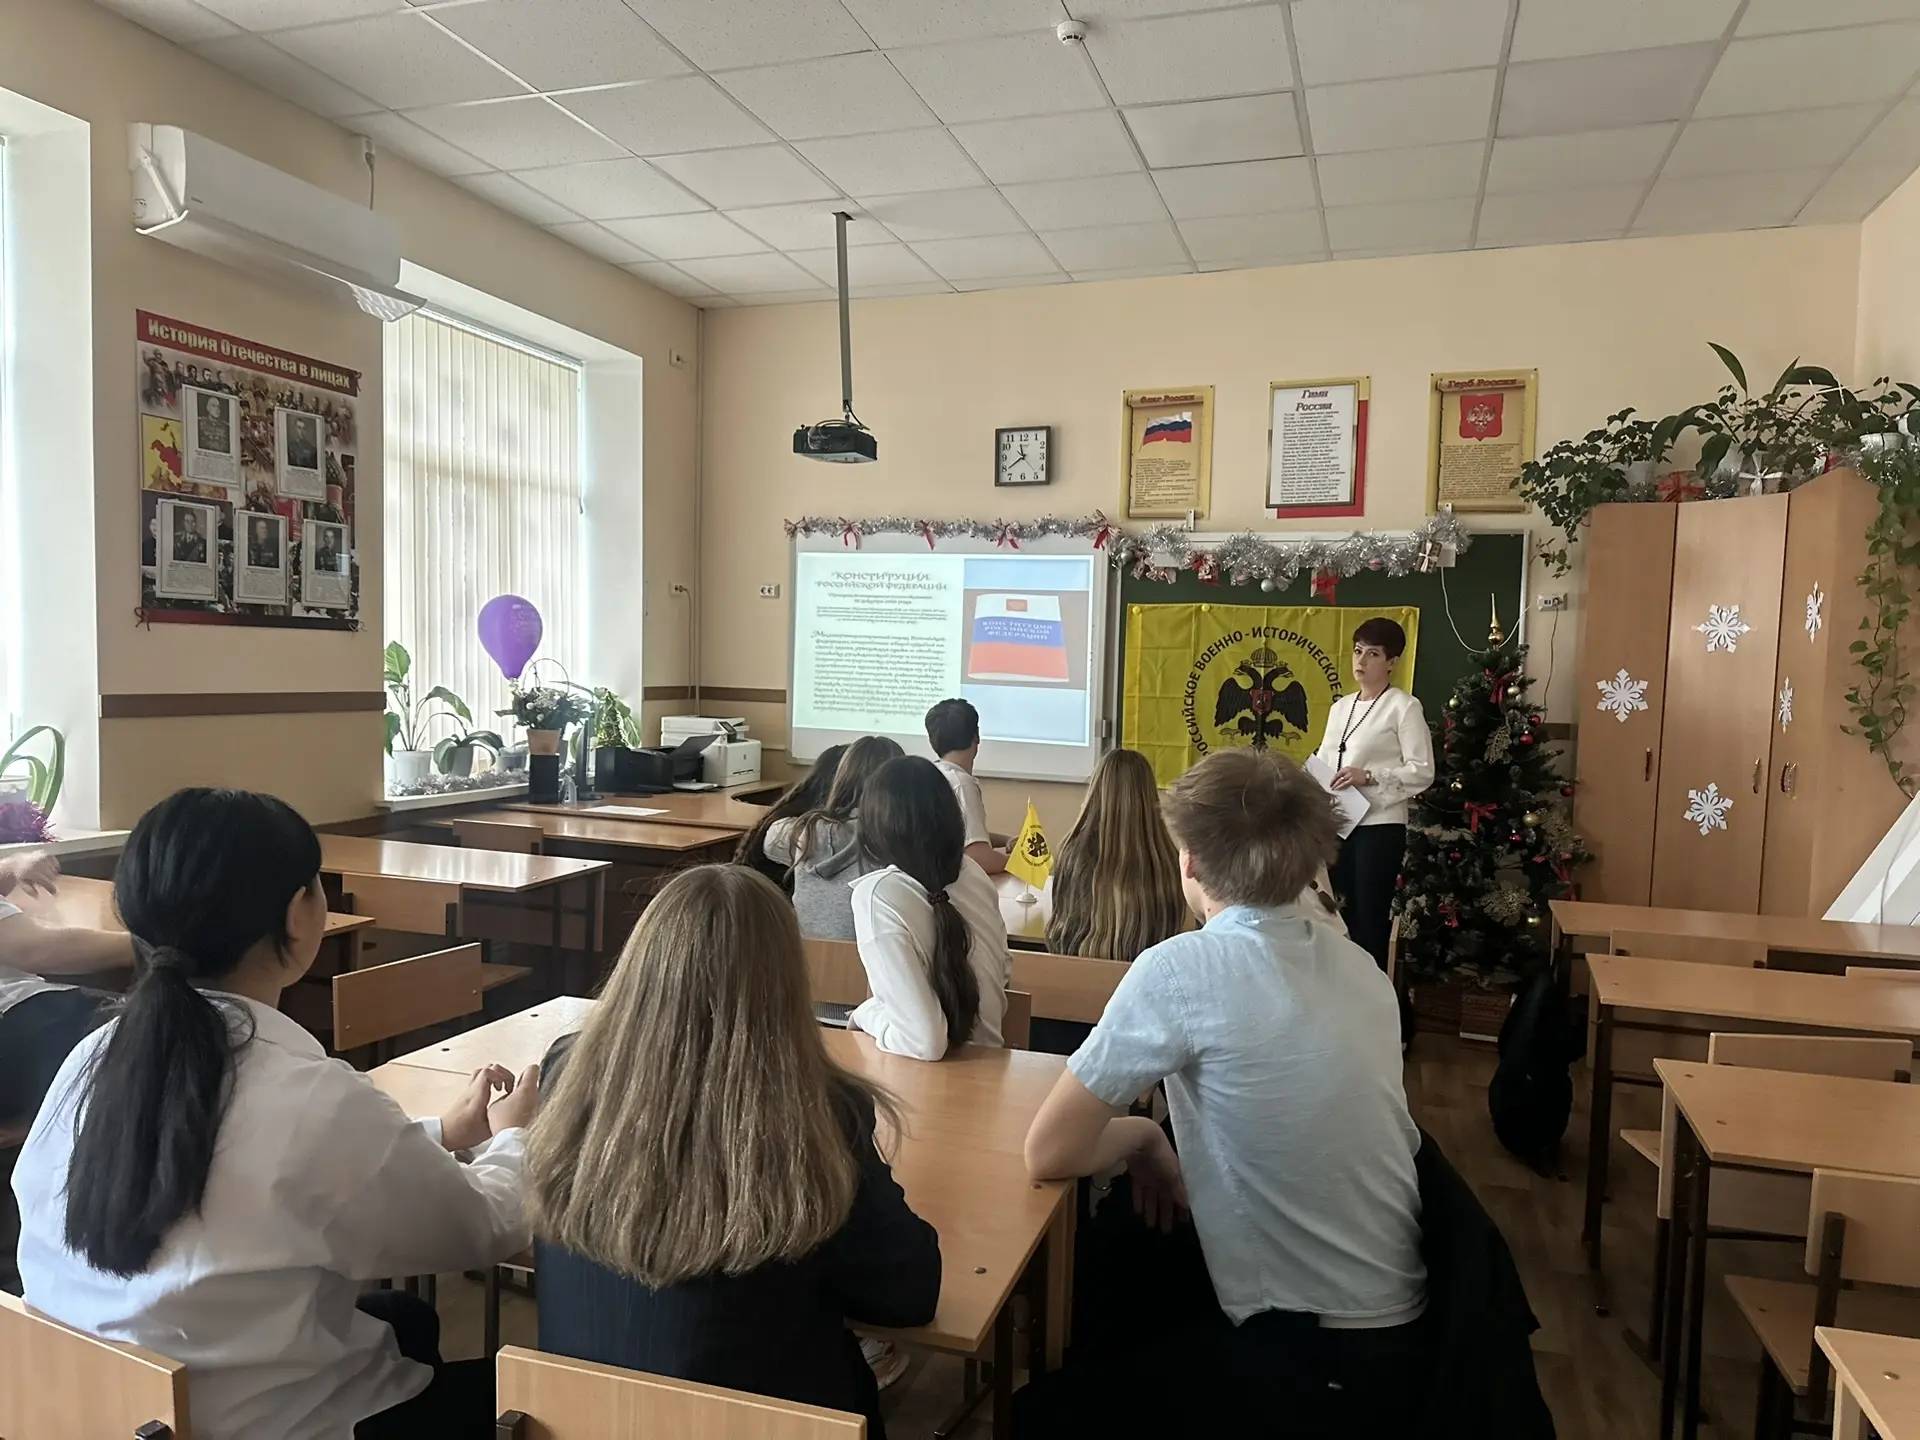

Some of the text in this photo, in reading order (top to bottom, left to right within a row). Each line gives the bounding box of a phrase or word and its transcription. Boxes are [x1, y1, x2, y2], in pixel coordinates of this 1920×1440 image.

[148, 318, 350, 389] История Отечества в лицах
[1477, 378, 1518, 387] России
[1301, 389, 1329, 399] Гимн
[1296, 402, 1333, 411] России
[1006, 434, 1014, 442] 11
[1020, 433, 1029, 442] 12
[1034, 433, 1038, 441] 1
[1002, 443, 1011, 451] 10
[1040, 441, 1045, 449] 2
[1039, 452, 1045, 460] 3
[1040, 463, 1044, 471] 4
[1033, 472, 1039, 480] 5
[832, 571, 930, 581] КОНСТИТУЦИЯ
[815, 580, 947, 592] РОССИЙСКОЙ ФЕДЕРАЦИИ
[1182, 672, 1209, 757] ОССИЙСКОЕ
